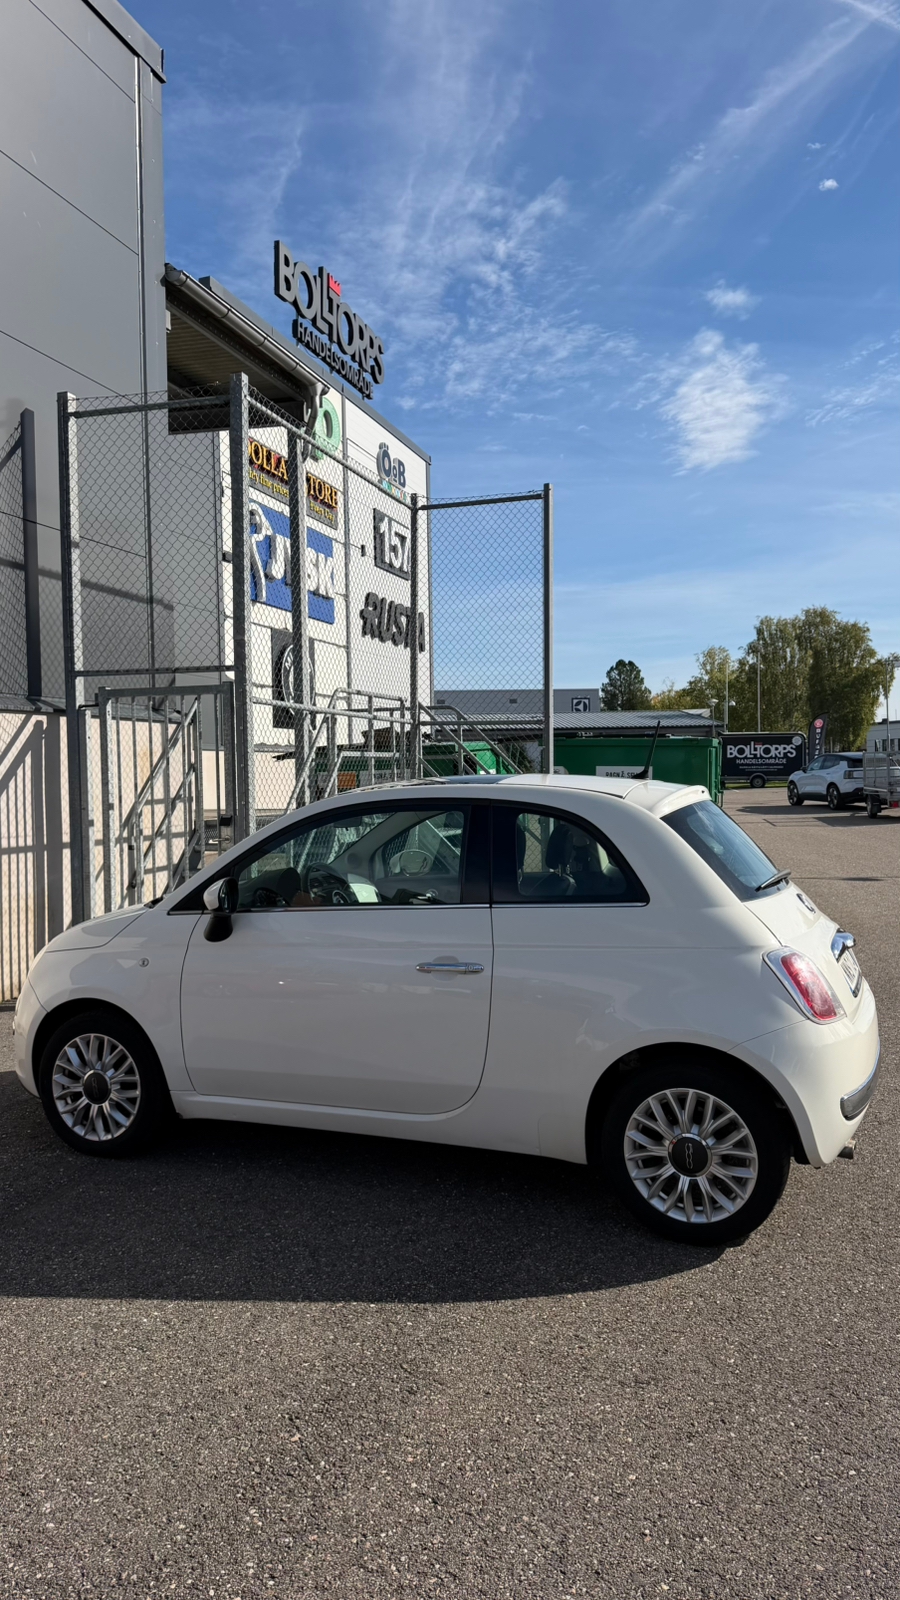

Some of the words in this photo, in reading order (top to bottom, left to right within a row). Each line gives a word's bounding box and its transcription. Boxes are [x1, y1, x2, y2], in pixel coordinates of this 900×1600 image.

[293, 319, 374, 400] HANDELSOMRÅDE
[248, 441, 289, 481] OLLA
[306, 473, 338, 508] TORE
